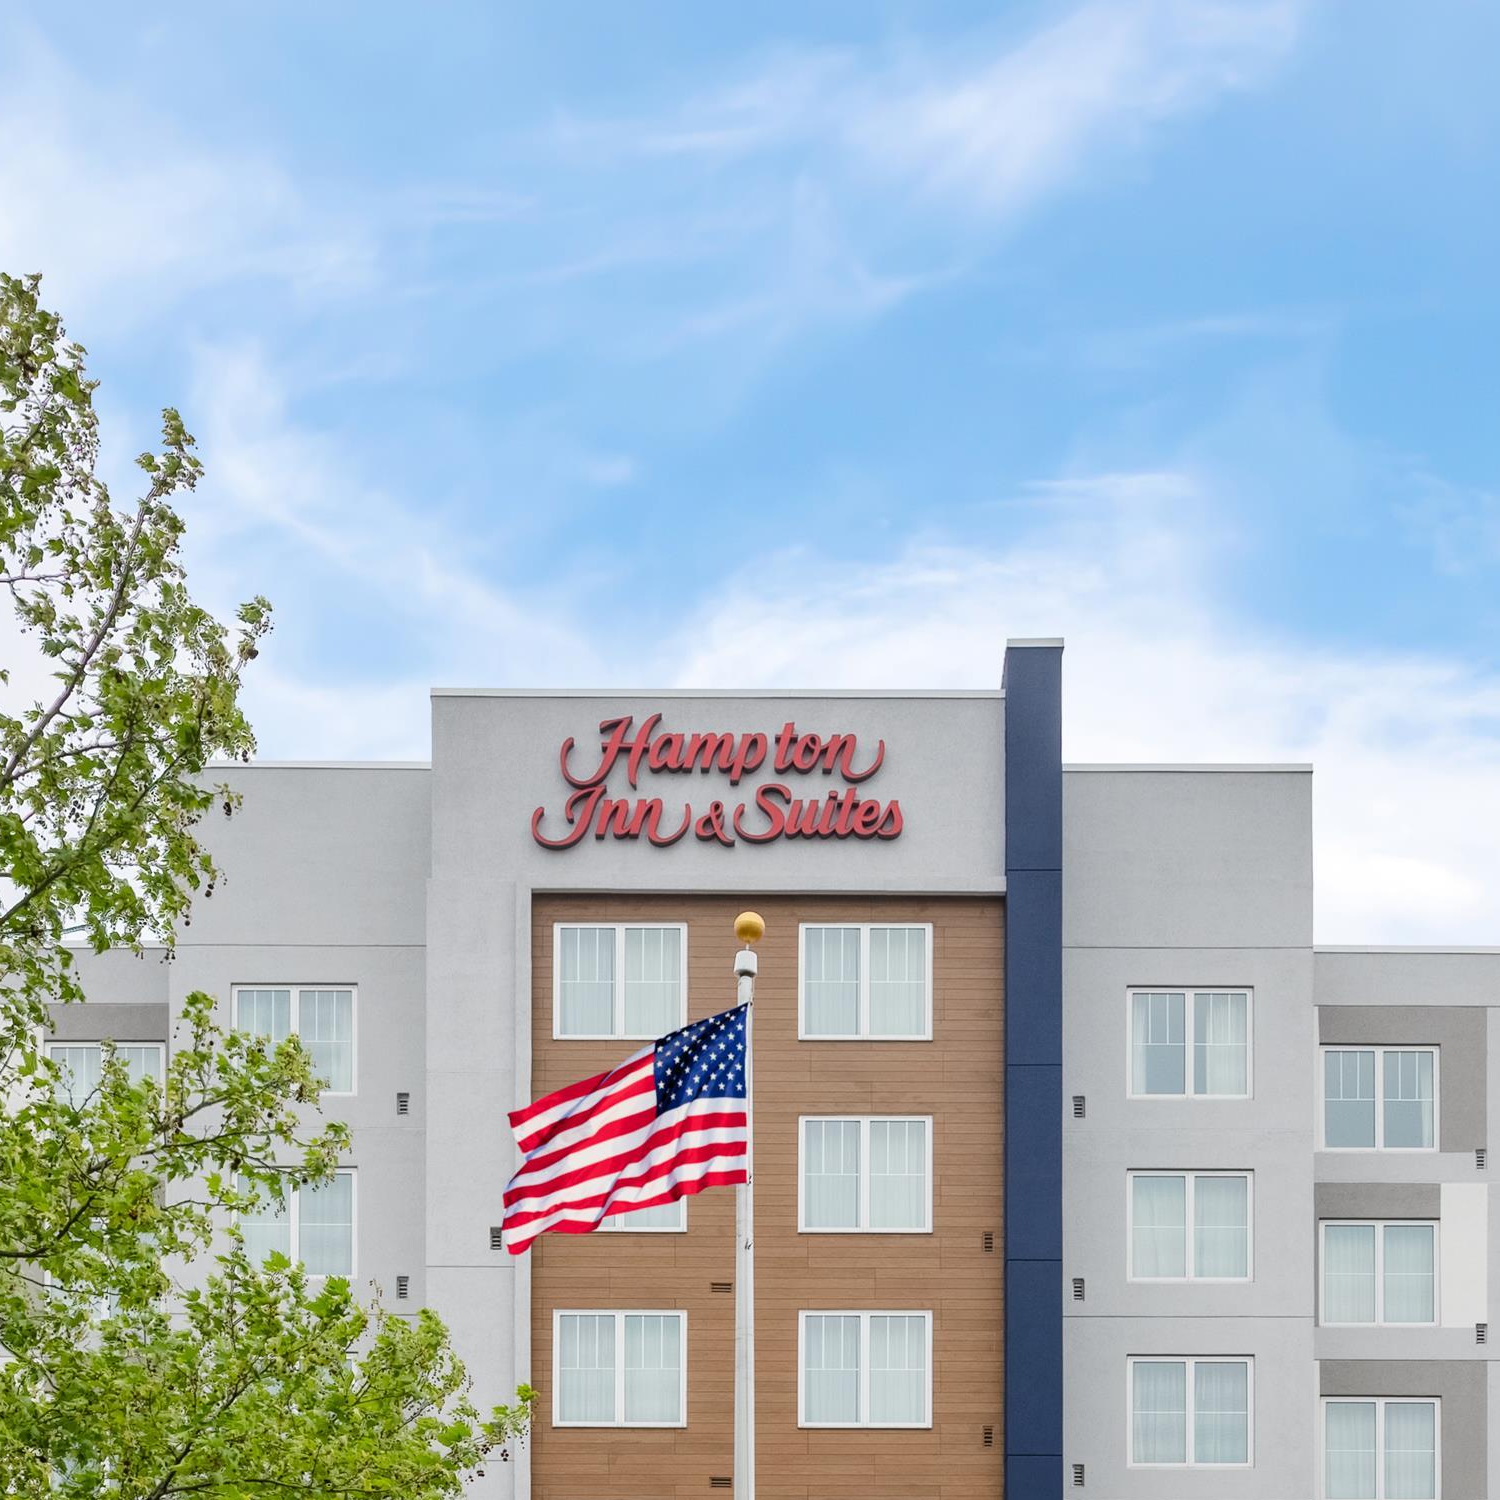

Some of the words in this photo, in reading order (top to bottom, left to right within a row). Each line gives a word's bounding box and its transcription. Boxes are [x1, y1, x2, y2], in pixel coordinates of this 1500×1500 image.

[560, 713, 885, 790] Hampton
[532, 784, 691, 850] Inn
[695, 801, 735, 847] &
[733, 783, 903, 844] Suites
